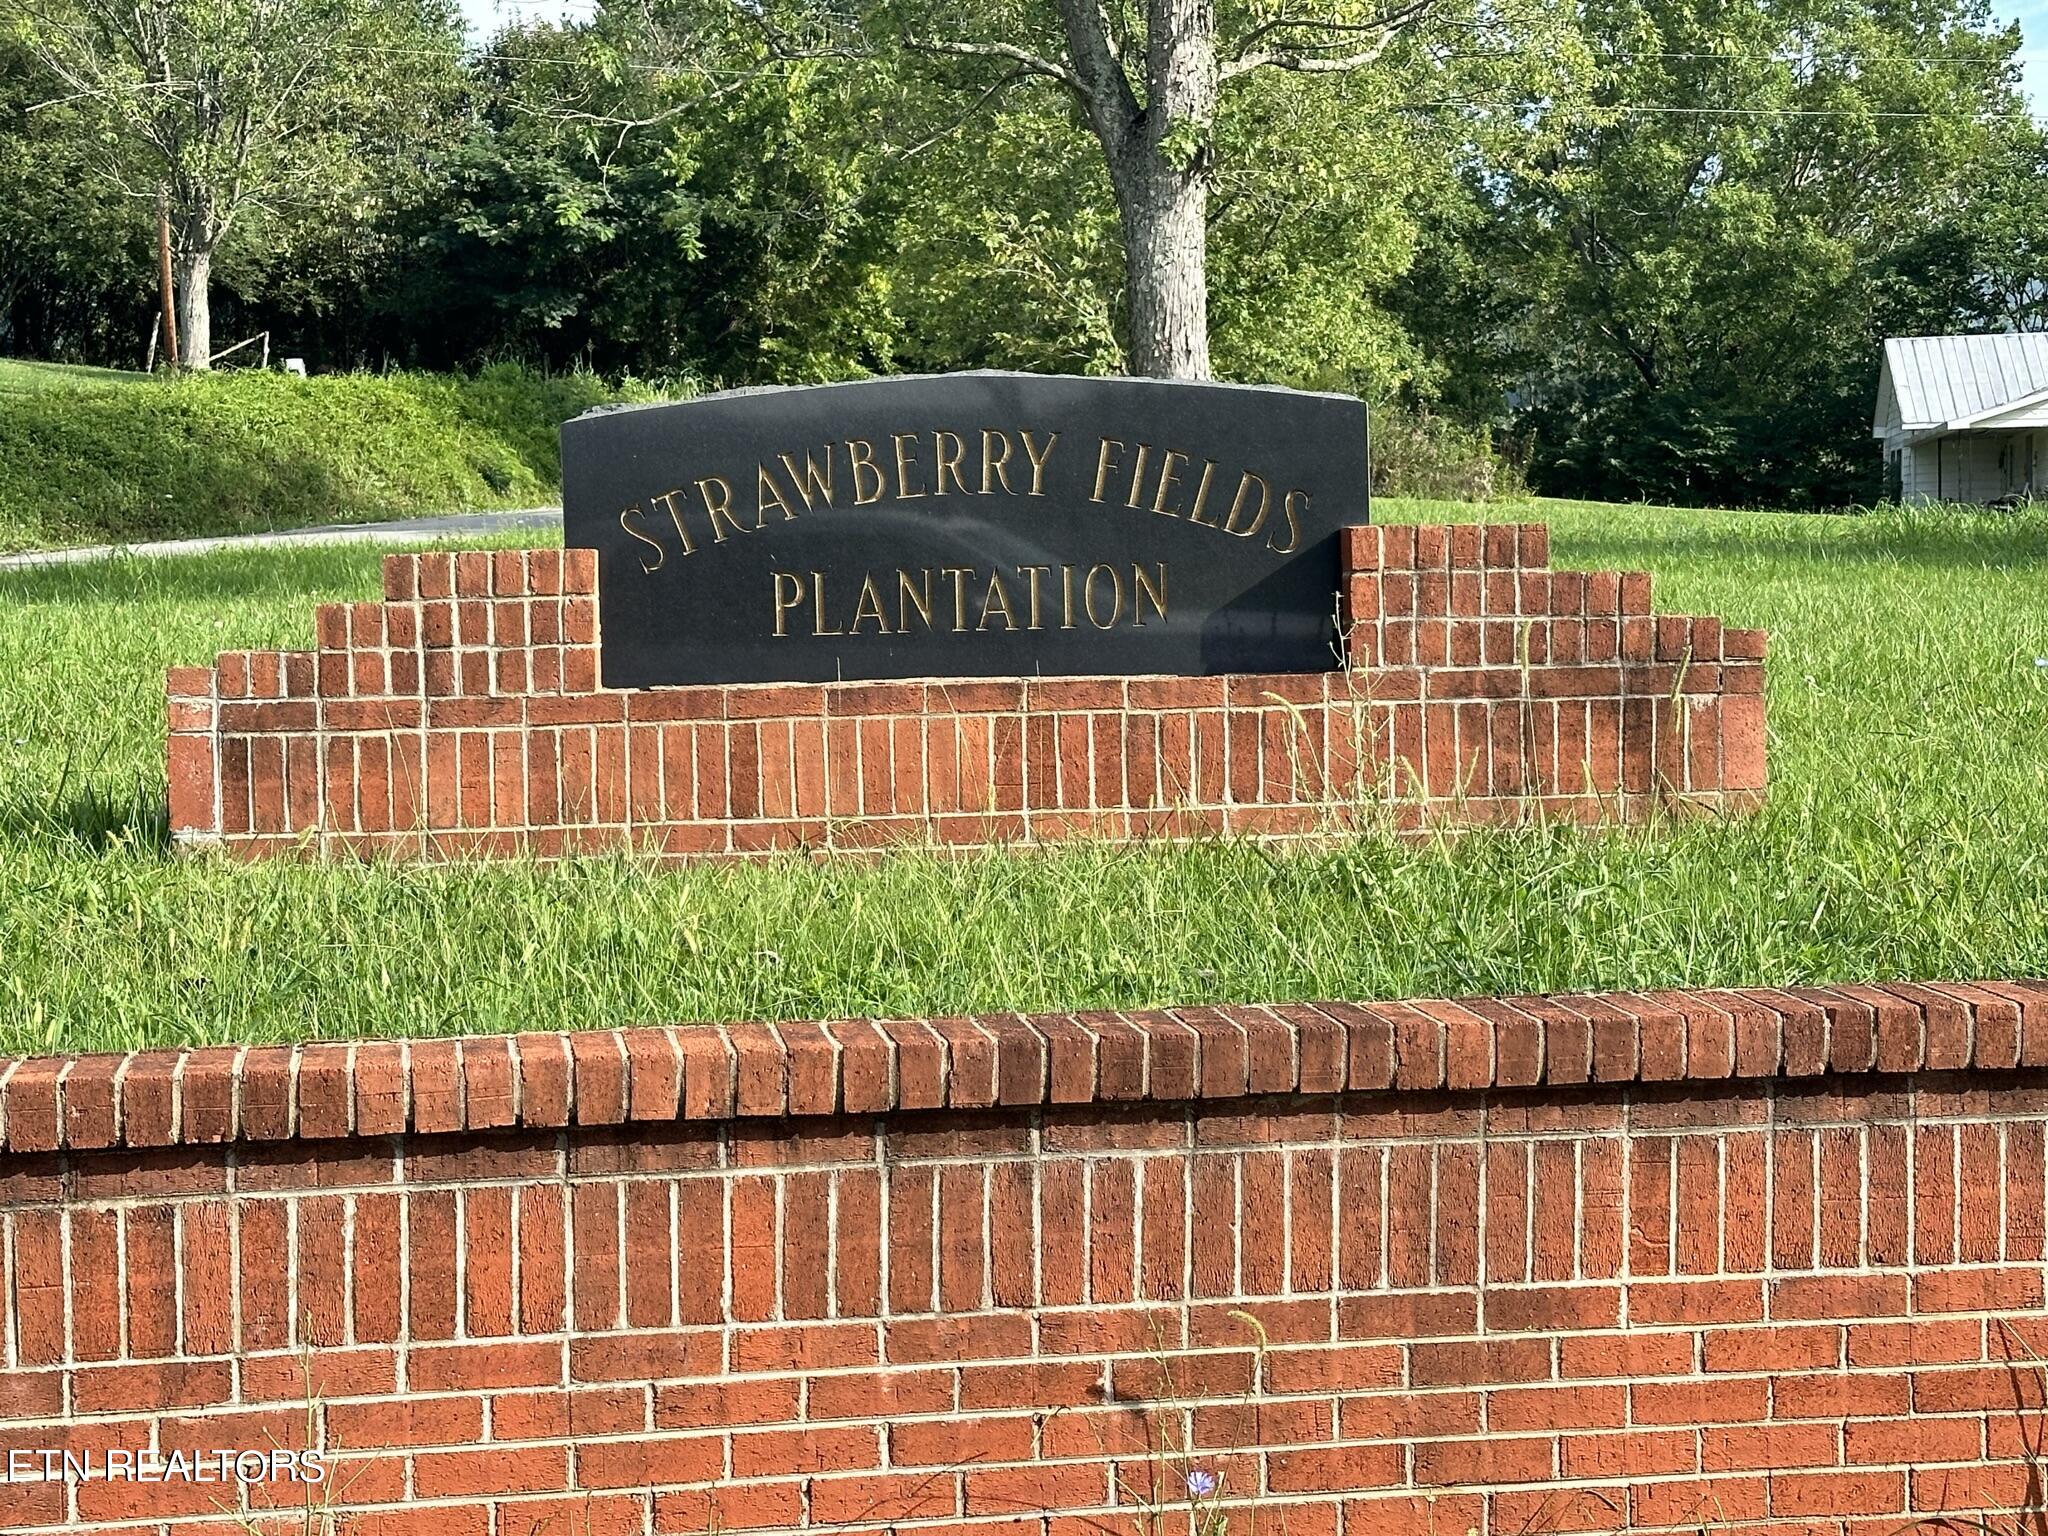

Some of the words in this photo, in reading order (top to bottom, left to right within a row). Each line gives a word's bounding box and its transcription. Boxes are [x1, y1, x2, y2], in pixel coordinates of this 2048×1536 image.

[619, 428, 1062, 575] STRAWBERRY
[1090, 435, 1313, 555] FIELDS
[771, 560, 1171, 638] PLANTATION
